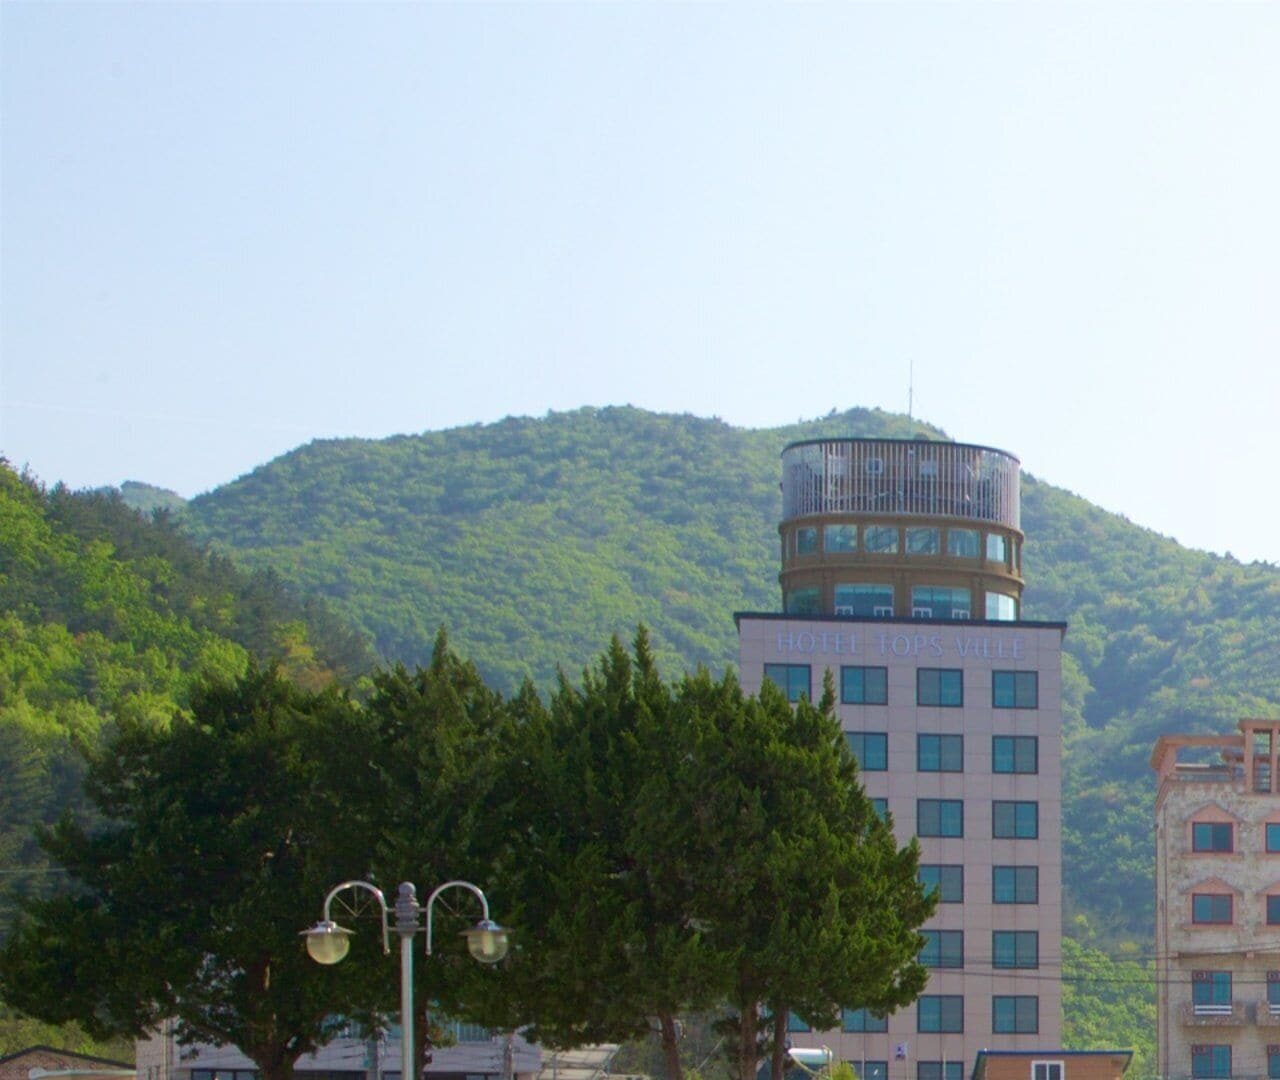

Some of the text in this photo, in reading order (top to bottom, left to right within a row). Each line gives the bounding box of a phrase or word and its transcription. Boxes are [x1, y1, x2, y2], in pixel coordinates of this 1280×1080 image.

[777, 631, 1026, 660] HOTEL TOPS VILLE
